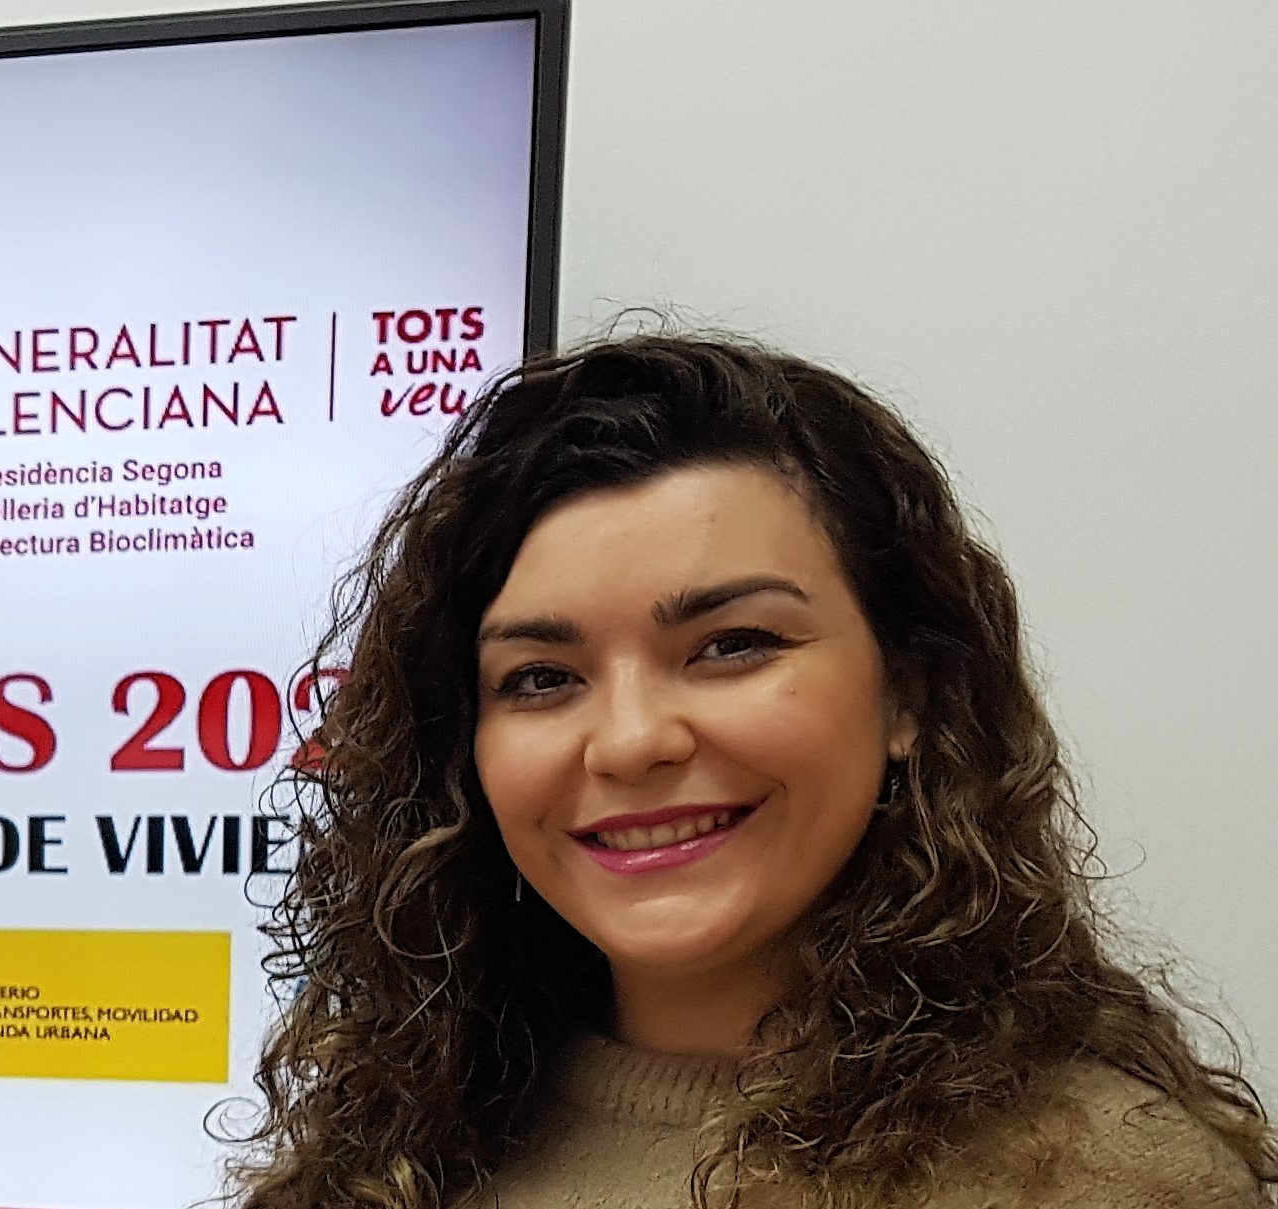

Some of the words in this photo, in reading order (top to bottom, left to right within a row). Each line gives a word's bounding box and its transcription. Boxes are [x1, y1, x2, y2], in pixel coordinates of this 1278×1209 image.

[371, 306, 485, 344] TOTS
[370, 352, 393, 376] A
[406, 348, 482, 374] UNA
[123, 459, 223, 485] Segona
[75, 493, 227, 519] d'Habitatge
[89, 526, 255, 553] Bioclimàtica
[97, 1007, 199, 1024] MOVILIDAD
[36, 1025, 112, 1041] URBANA
